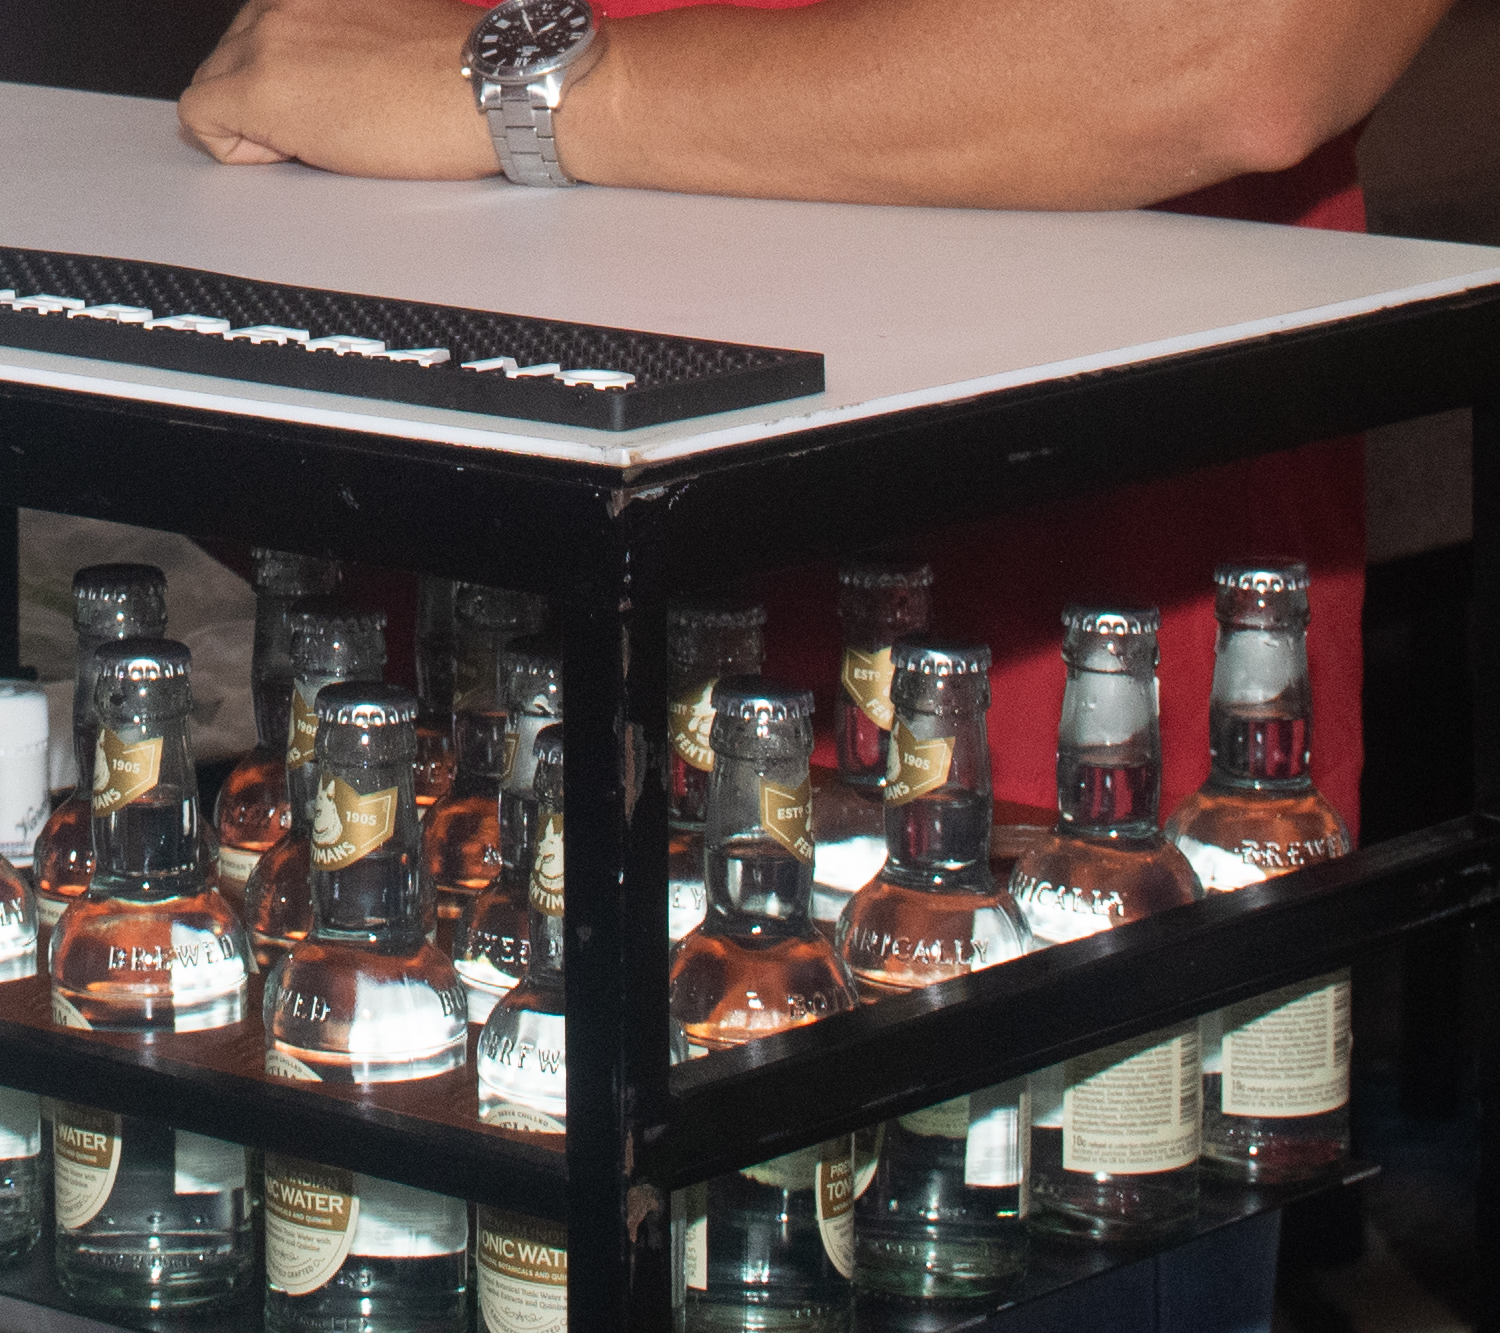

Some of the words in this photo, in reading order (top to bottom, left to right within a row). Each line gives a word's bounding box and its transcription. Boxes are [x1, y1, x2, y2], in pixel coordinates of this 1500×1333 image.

[112, 758, 141, 774] 1905
[903, 752, 931, 771] 1905
[345, 810, 377, 826] 1905
[56, 1122, 108, 1153] WATER
[280, 1183, 345, 1214] WATER
